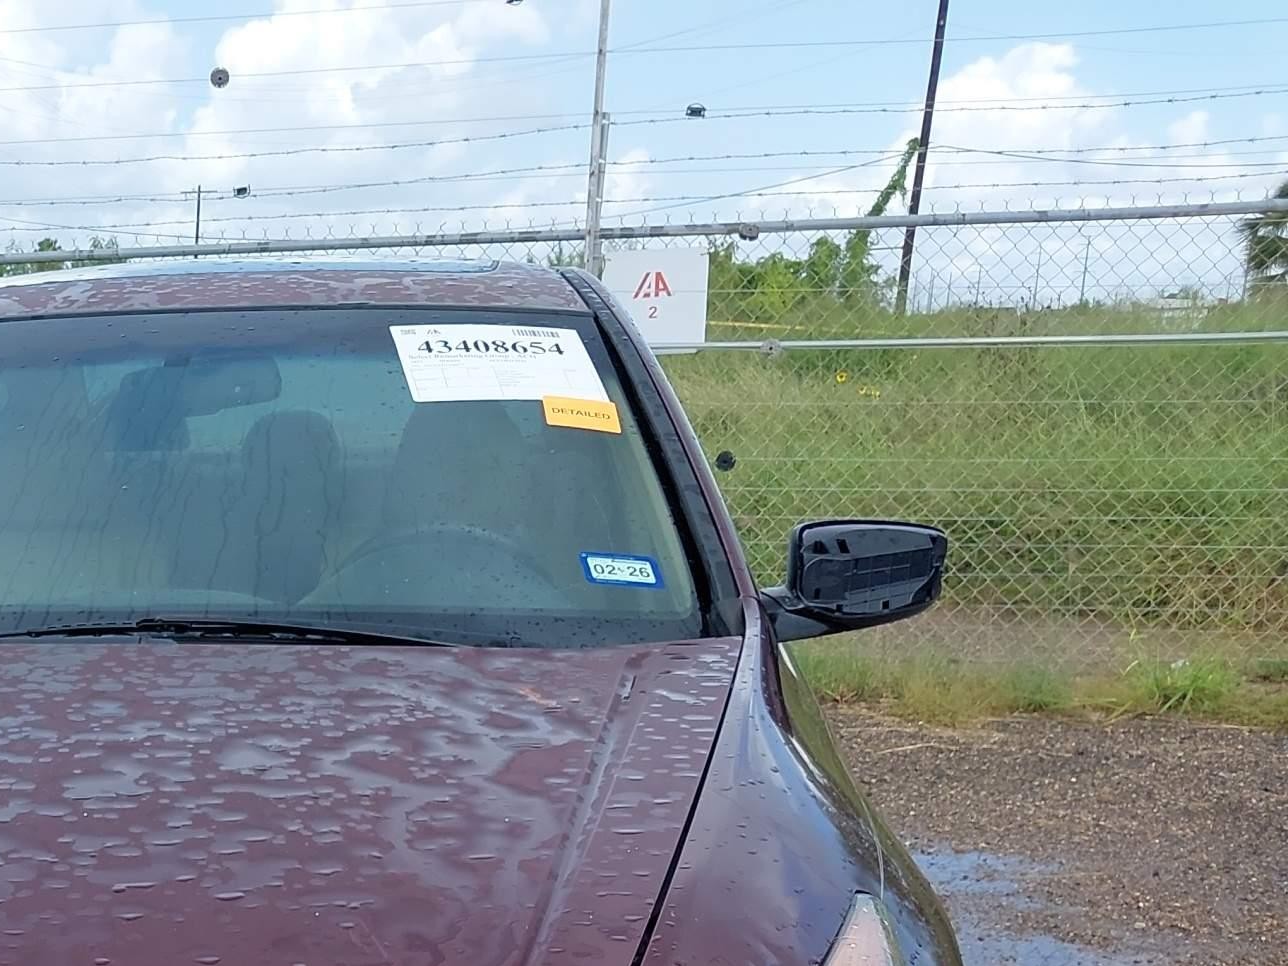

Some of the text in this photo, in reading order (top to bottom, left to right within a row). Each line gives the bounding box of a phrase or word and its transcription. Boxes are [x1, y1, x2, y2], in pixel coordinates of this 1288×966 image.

[648, 306, 657, 319] 2
[417, 339, 565, 355] 43408654
[551, 406, 611, 421] DETAILED
[593, 563, 651, 578] 02 26
